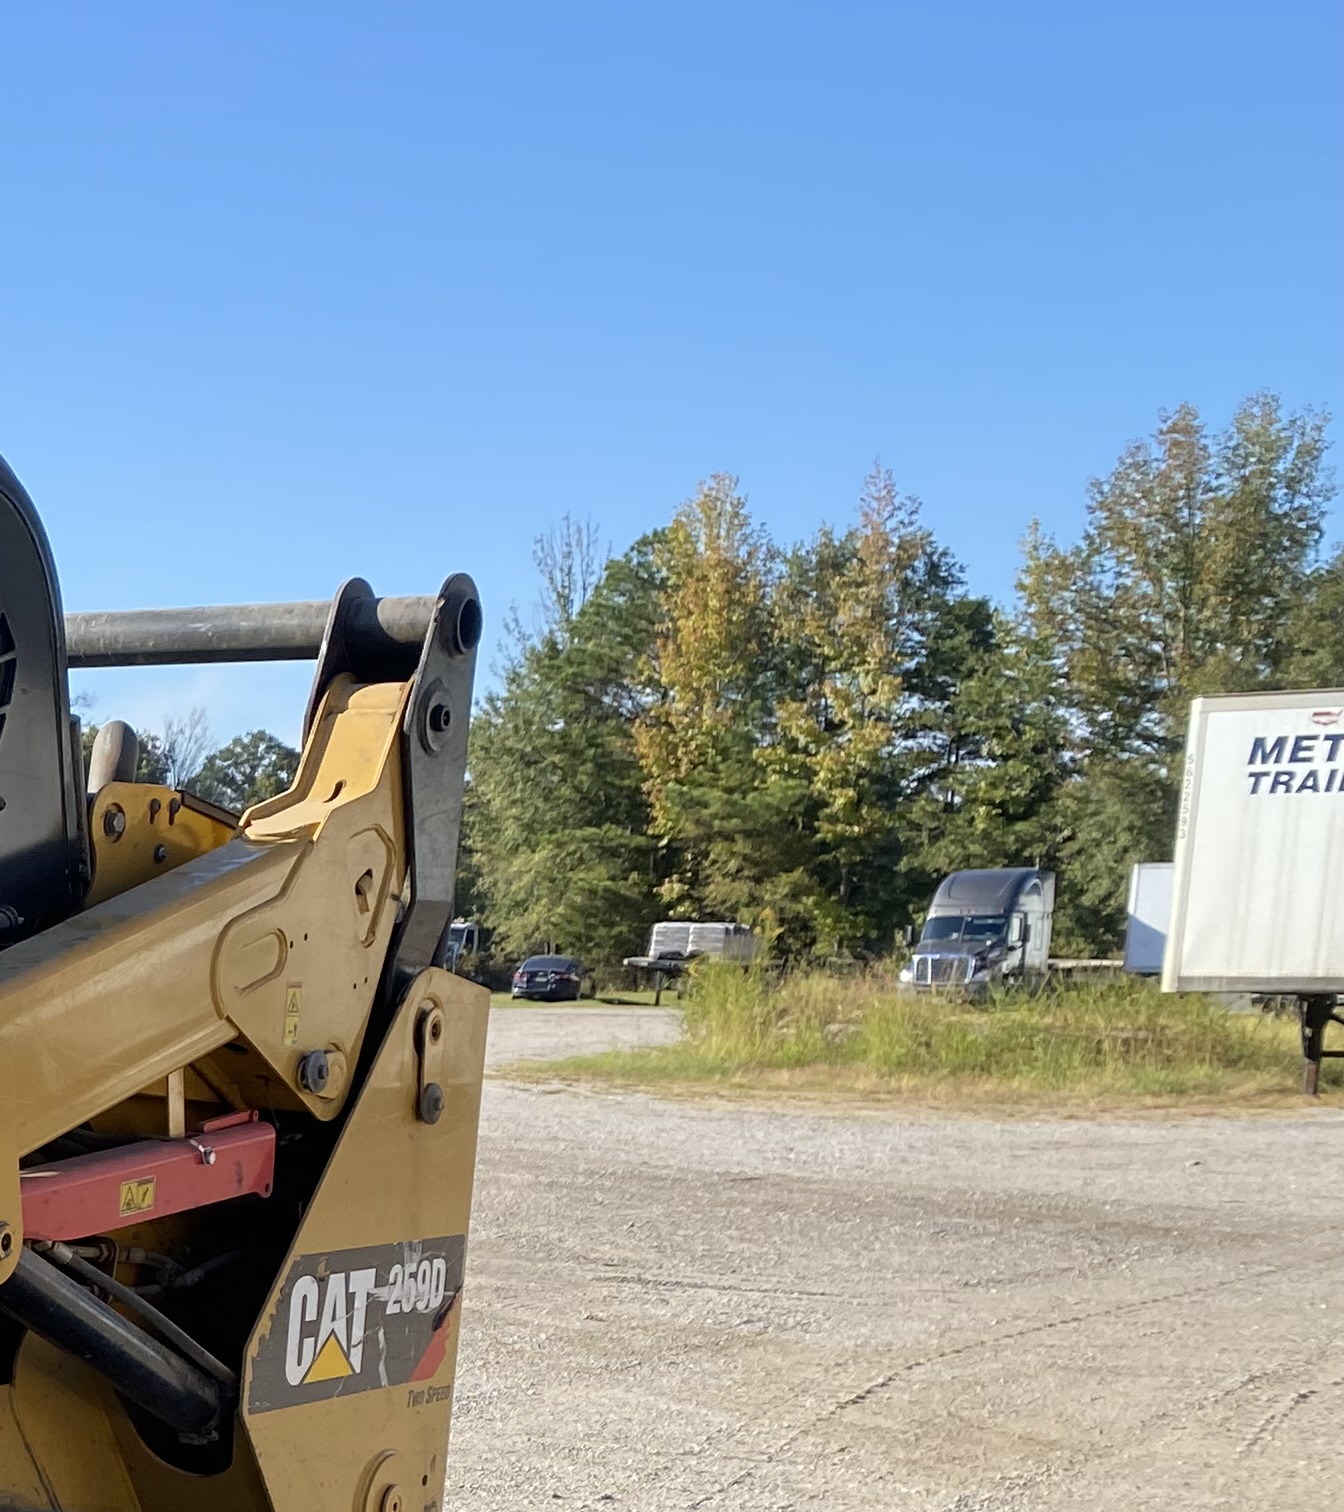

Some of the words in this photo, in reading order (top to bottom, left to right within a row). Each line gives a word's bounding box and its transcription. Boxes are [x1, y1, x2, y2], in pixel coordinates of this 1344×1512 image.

[1179, 754, 1195, 839] 5622593
[1248, 769, 1344, 795] TRAI
[285, 1268, 377, 1386] CAT
[385, 1257, 447, 1315] 259D
